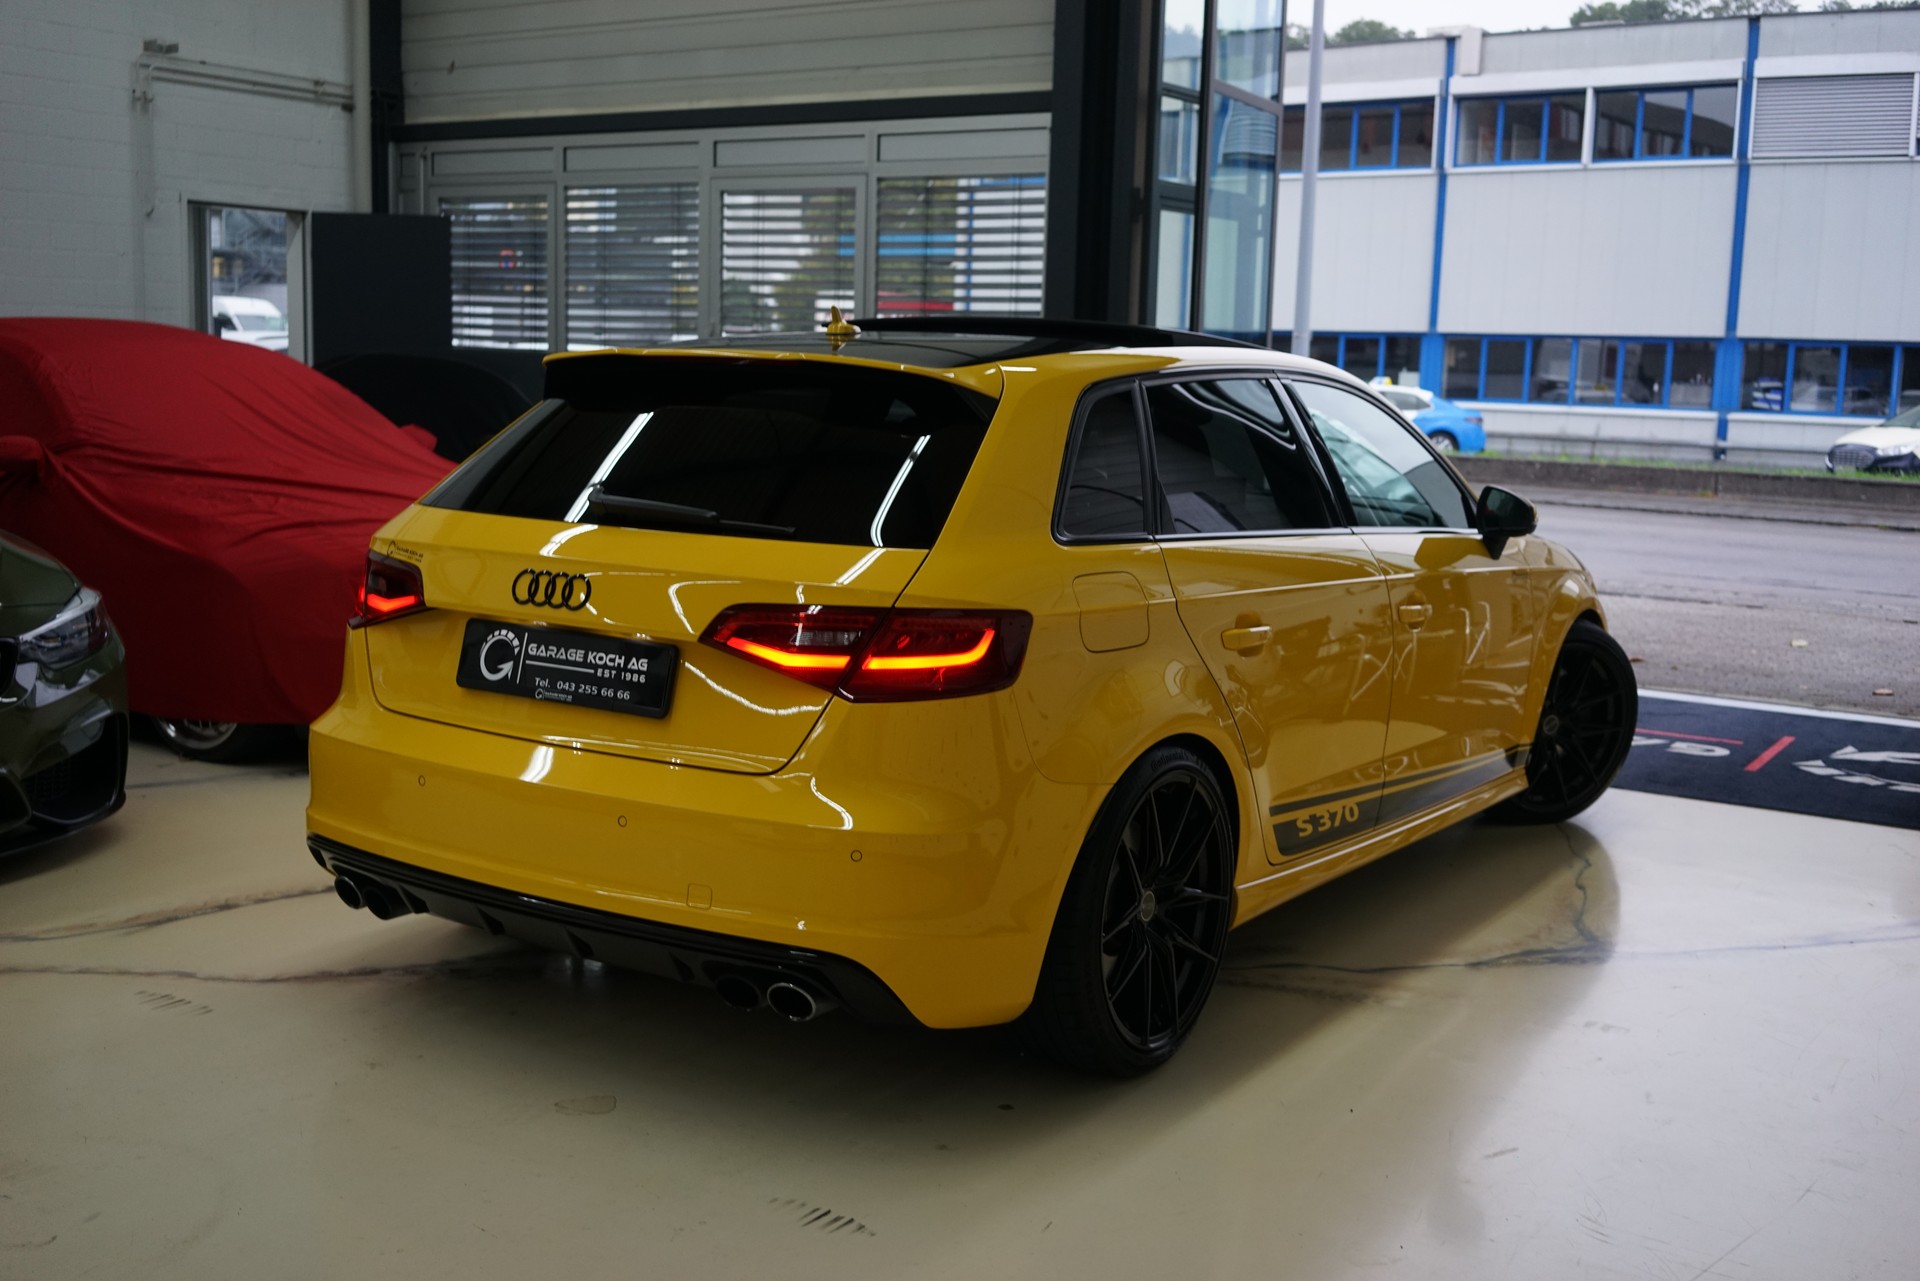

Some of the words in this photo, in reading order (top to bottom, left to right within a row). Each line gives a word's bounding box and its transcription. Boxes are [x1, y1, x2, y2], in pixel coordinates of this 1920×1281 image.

[528, 643, 585, 662] GARAGE
[587, 651, 625, 668] KOCH
[627, 657, 649, 671] AG
[597, 668, 616, 679] EST
[621, 671, 646, 683] 1986
[535, 677, 550, 688] Tel.
[556, 680, 576, 692] 043
[578, 684, 598, 696] 255
[601, 688, 614, 698] 66
[617, 690, 630, 700] 66
[1296, 817, 1313, 837] S
[1316, 802, 1359, 832] 370
